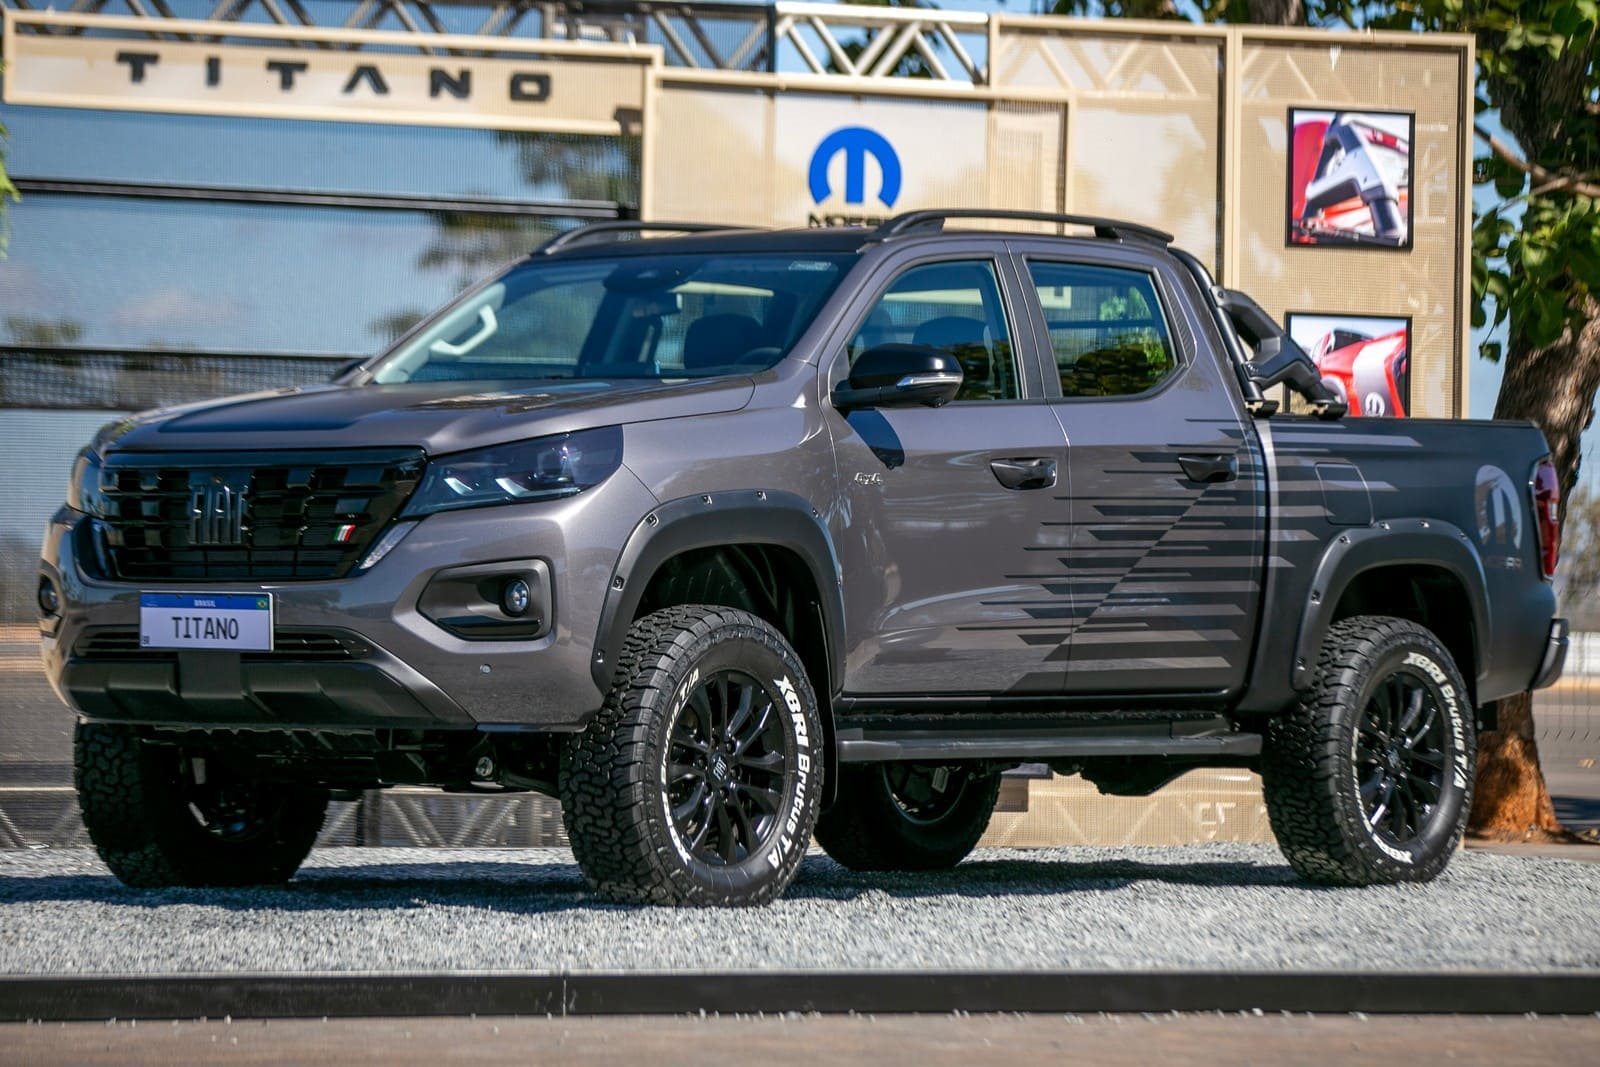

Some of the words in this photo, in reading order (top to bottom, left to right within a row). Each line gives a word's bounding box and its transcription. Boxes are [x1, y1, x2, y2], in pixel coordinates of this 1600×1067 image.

[115, 52, 552, 103] TITANO
[171, 616, 240, 640] TITANO
[773, 674, 809, 748] XBRI
[786, 753, 811, 839] Brutus
[767, 833, 793, 870] T/A
